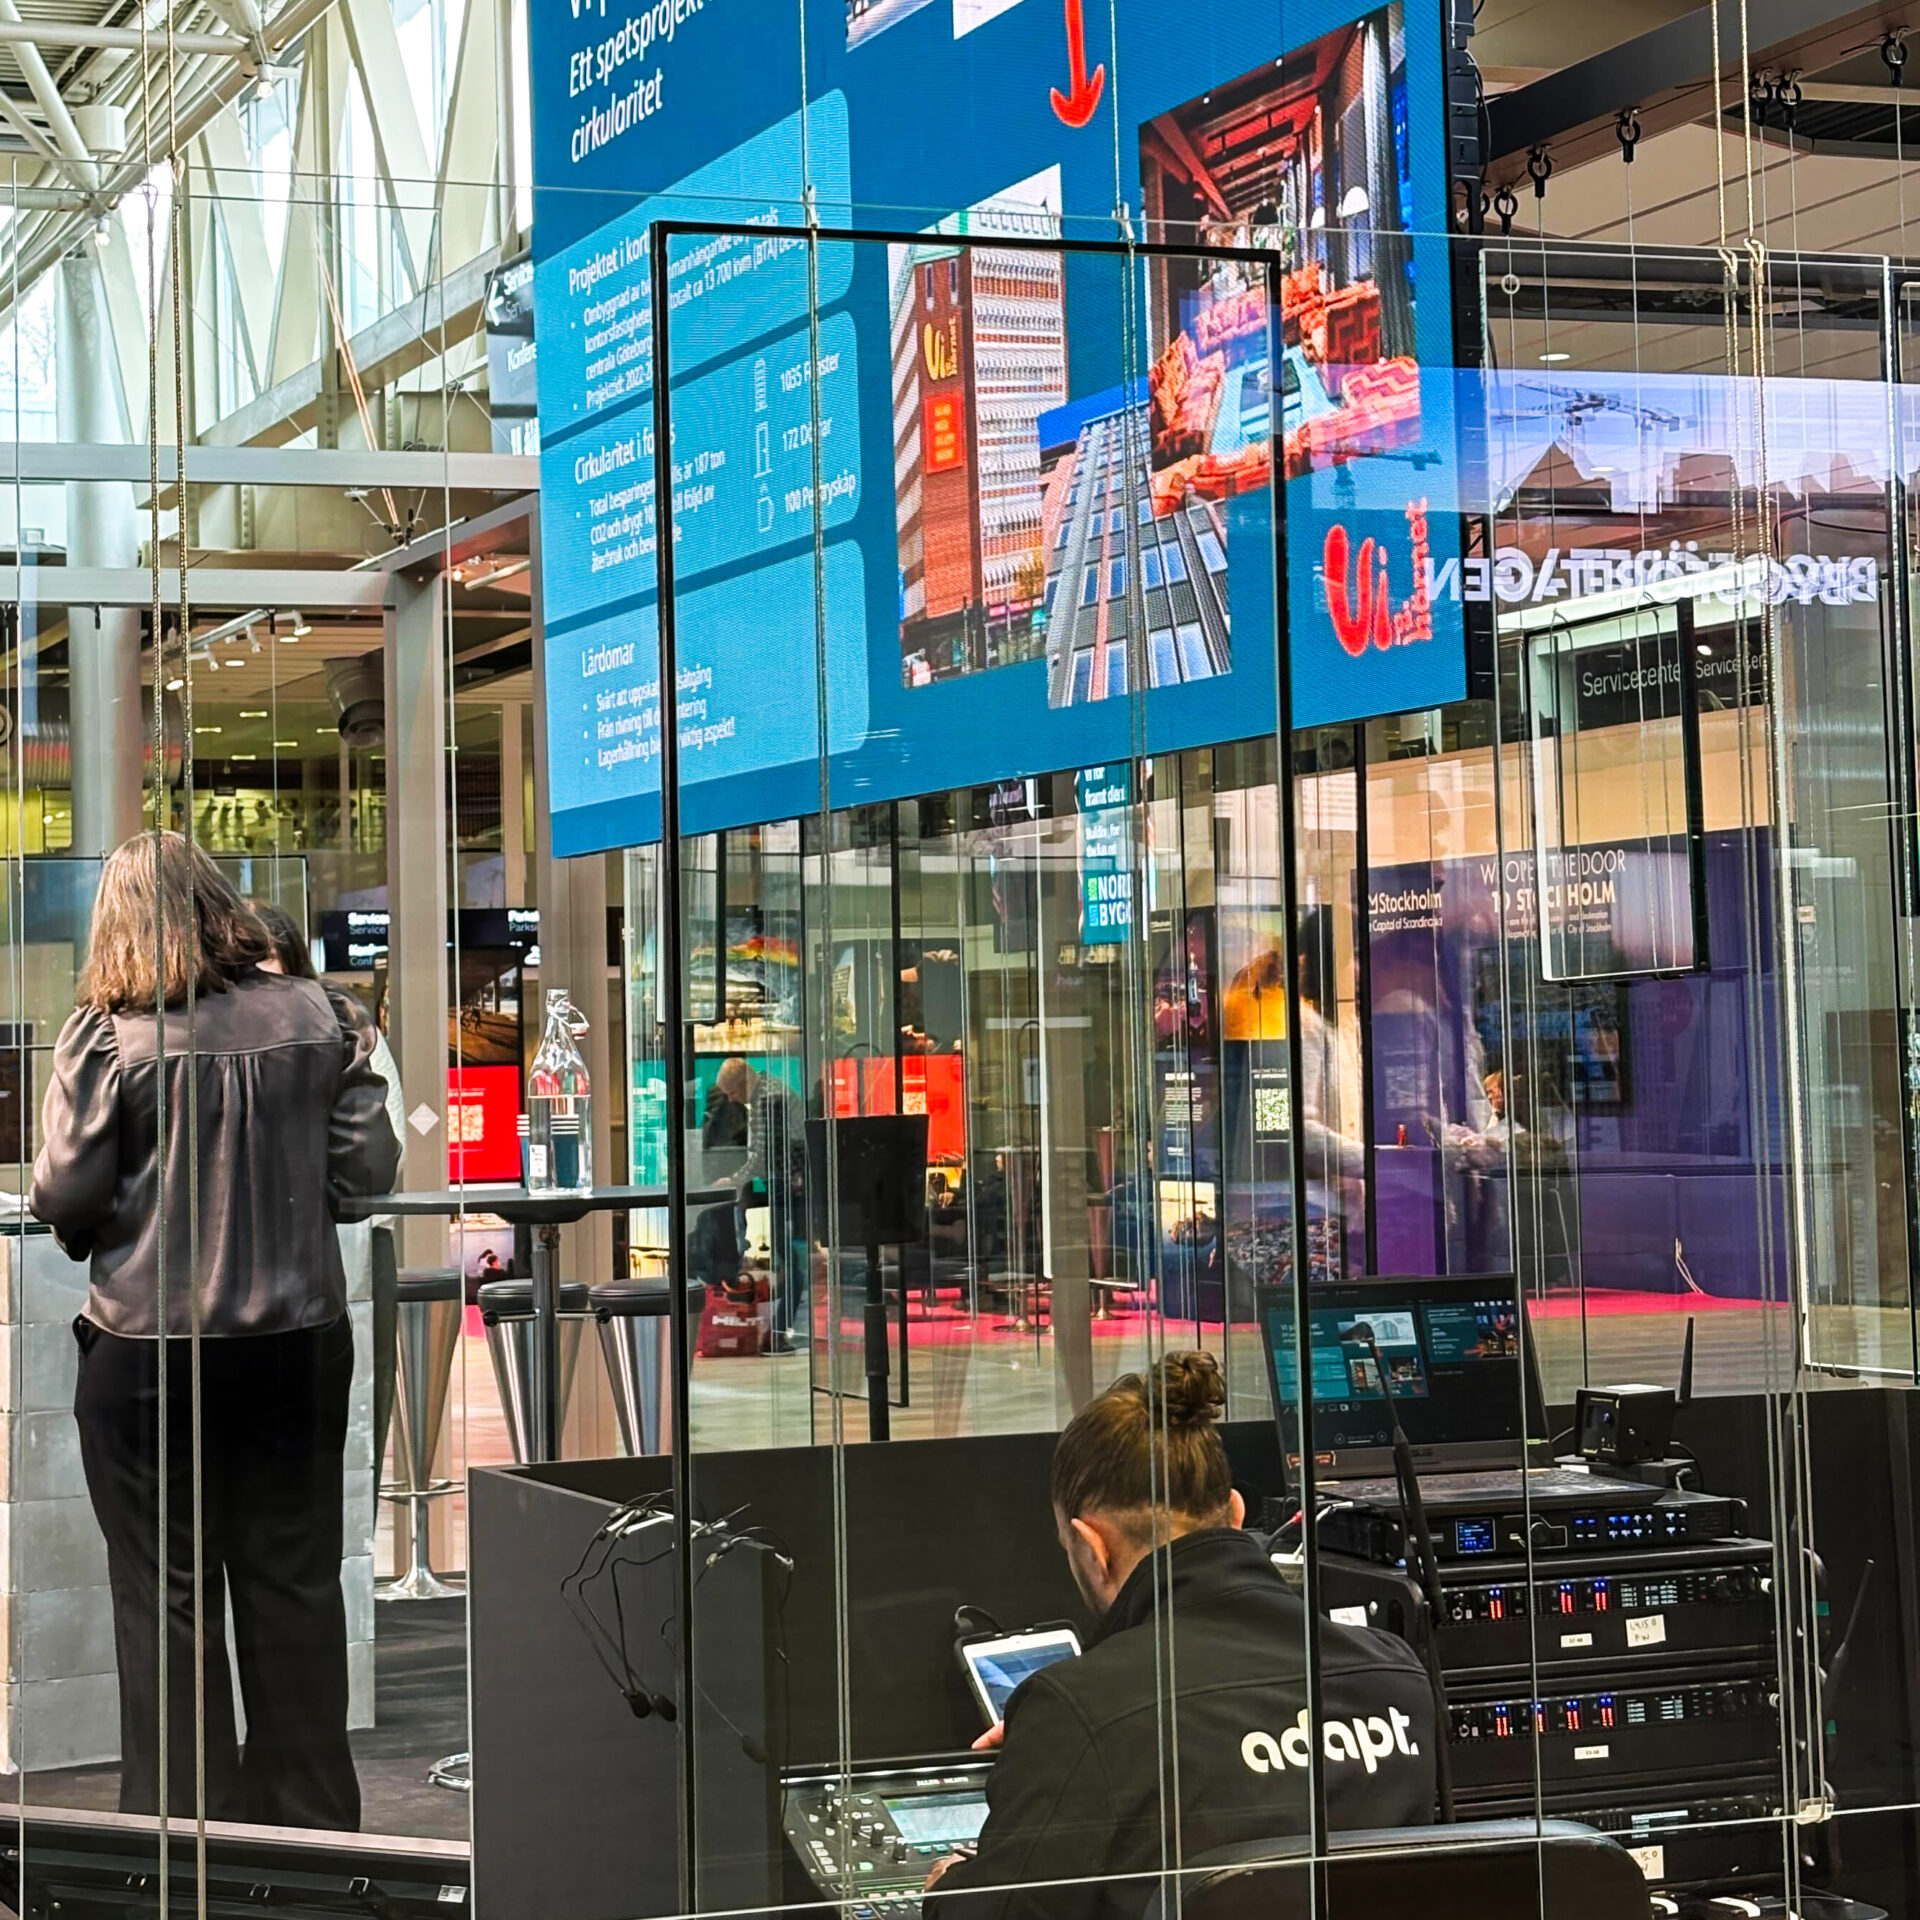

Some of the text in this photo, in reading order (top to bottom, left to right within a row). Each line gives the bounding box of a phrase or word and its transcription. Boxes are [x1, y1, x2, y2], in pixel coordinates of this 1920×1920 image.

[569, 46, 593, 98] Ett
[571, 67, 663, 163] cirkularitet
[569, 247, 619, 295] Projektet
[620, 241, 624, 266] i
[716, 260, 731, 285] 700
[575, 438, 635, 485] Cirkularitet
[582, 643, 635, 678] Lärdomar
[1583, 658, 1681, 697] Servicecente
[1506, 858, 1535, 883] OPE
[1582, 849, 1626, 876] DOOR
[1379, 888, 1442, 914] Stockholm
